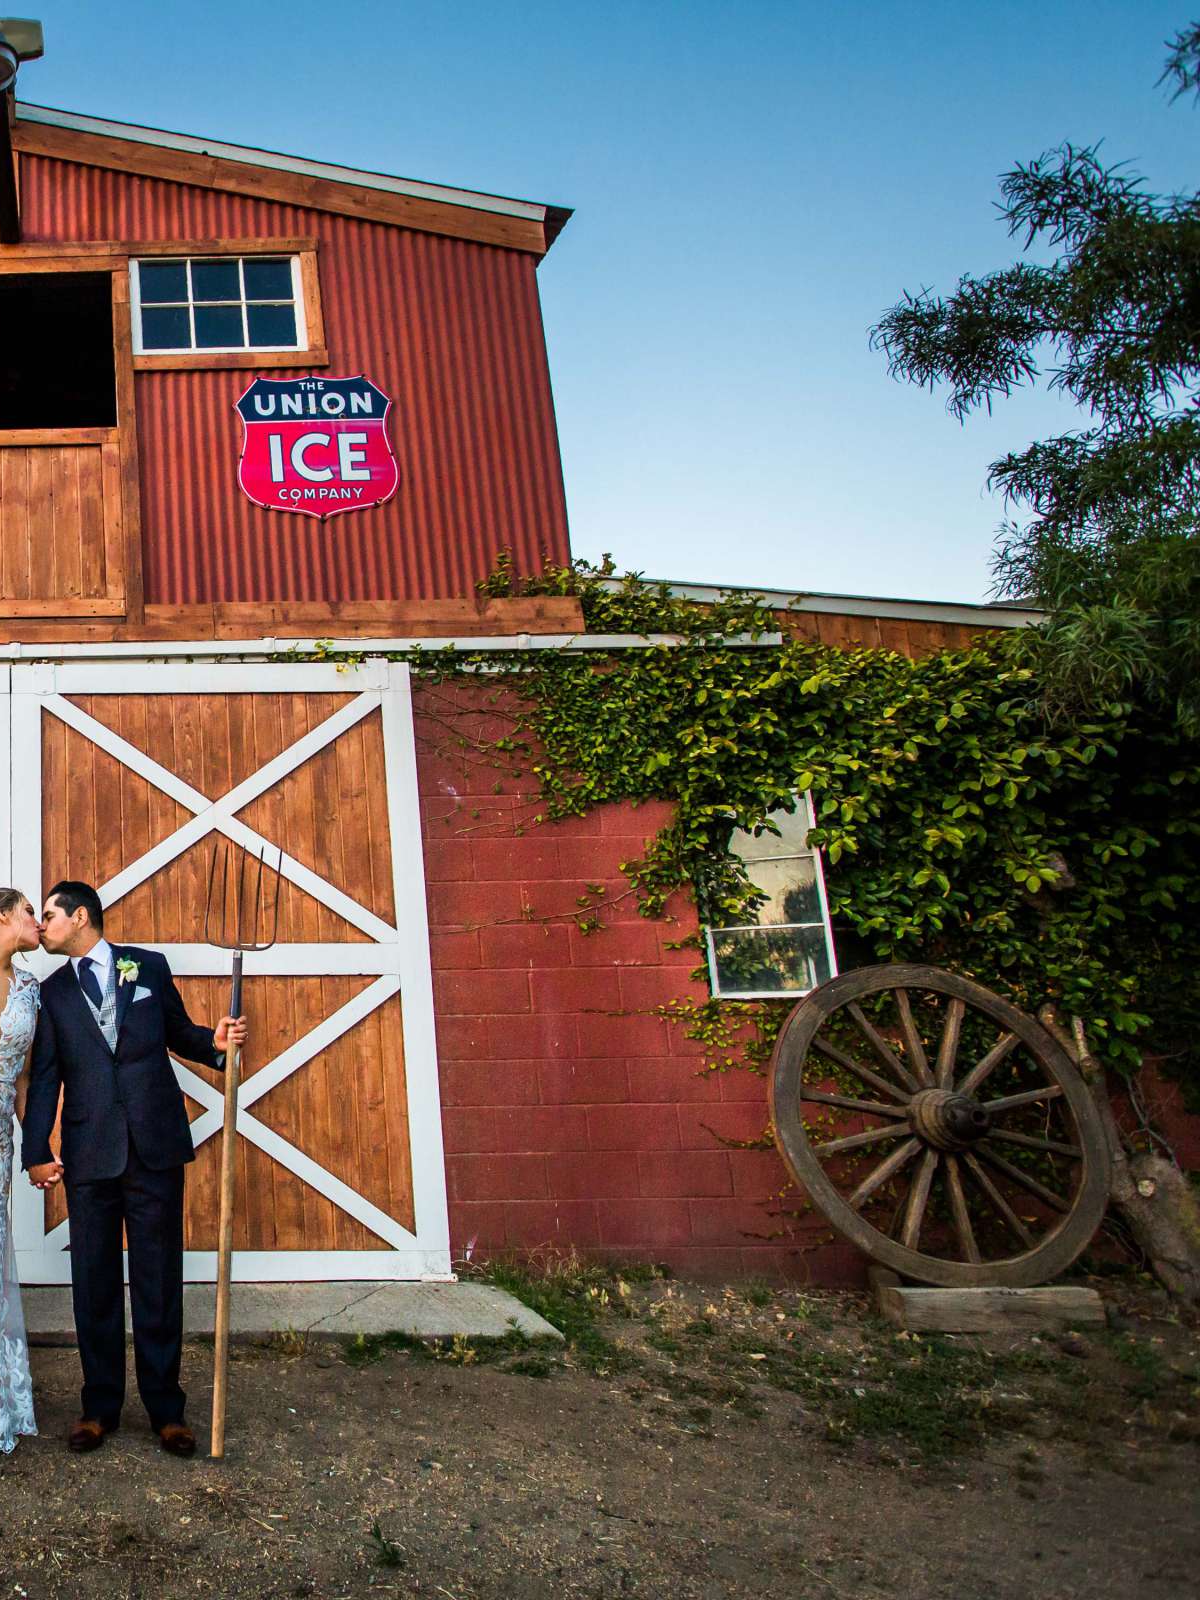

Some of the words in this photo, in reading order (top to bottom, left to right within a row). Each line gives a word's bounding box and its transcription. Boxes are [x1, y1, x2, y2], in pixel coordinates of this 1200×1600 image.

[299, 382, 325, 390] THE
[254, 392, 373, 416] UNION
[268, 432, 371, 483] ICE
[278, 487, 364, 500] COMPANY
